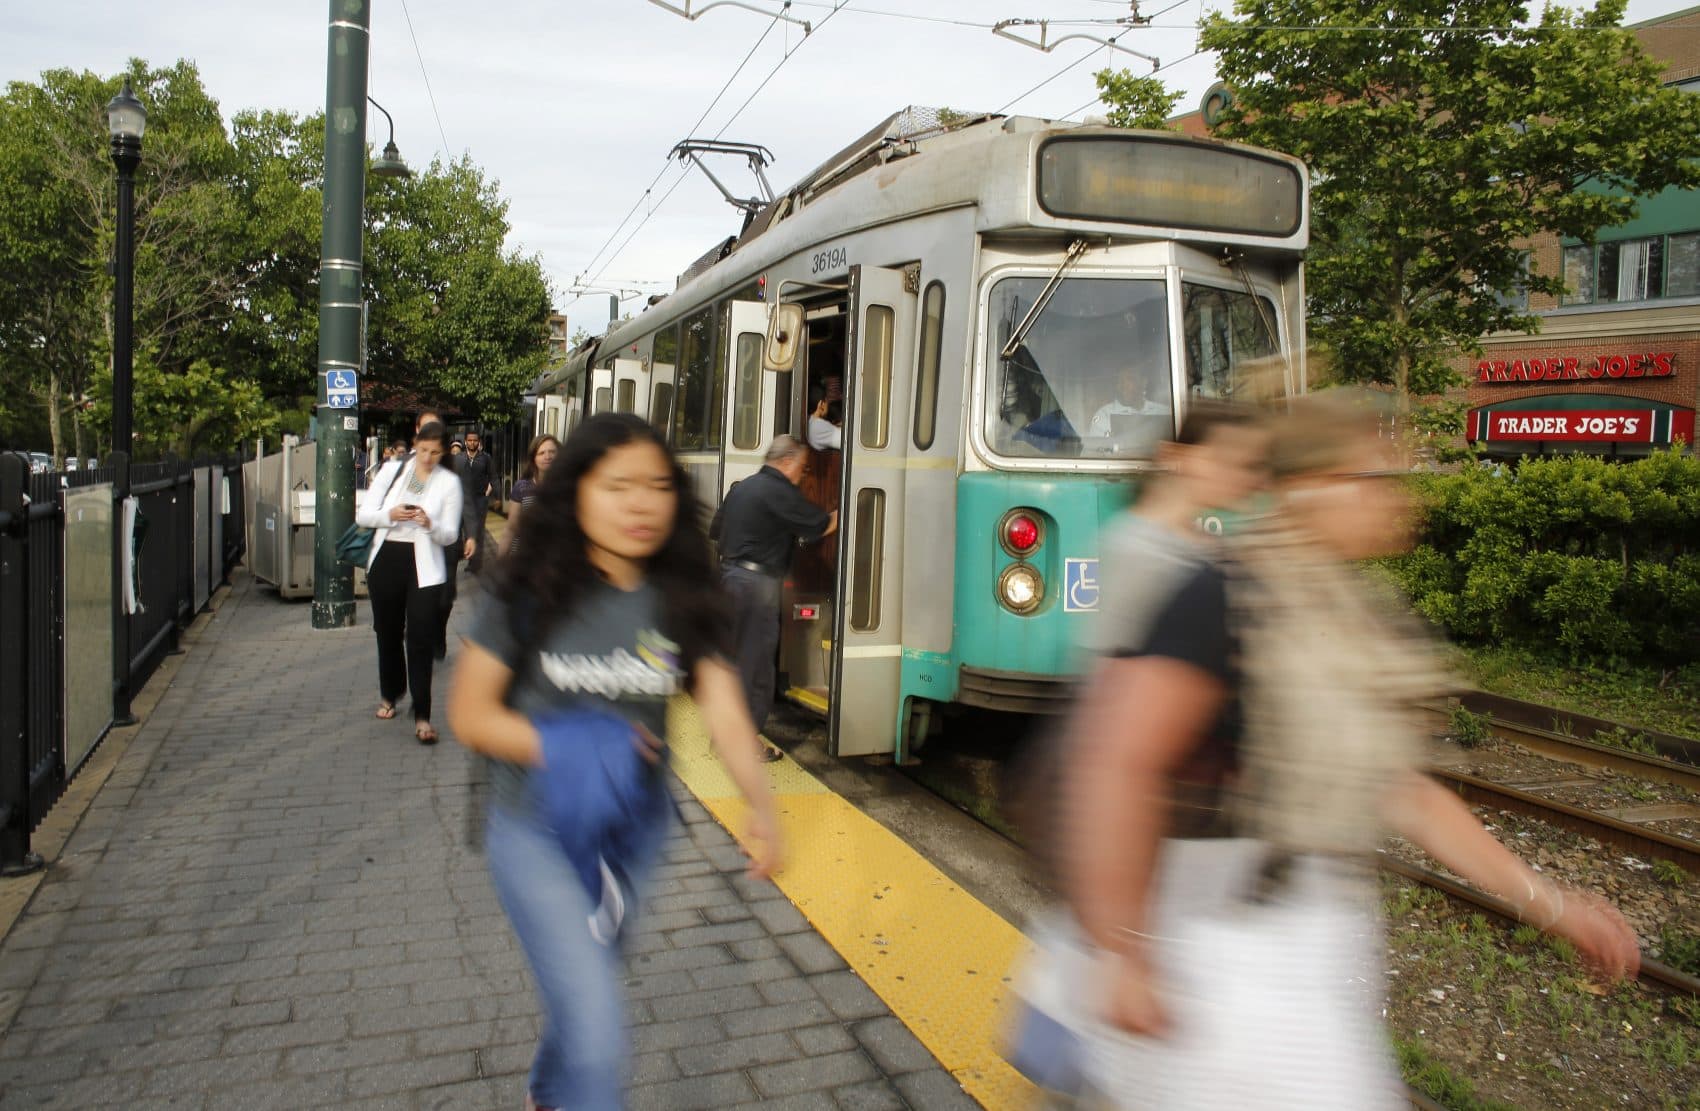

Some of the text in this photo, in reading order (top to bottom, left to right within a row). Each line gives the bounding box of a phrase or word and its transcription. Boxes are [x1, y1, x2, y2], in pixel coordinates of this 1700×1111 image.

[812, 247, 847, 274] 3619A
[1478, 352, 1674, 382] TRADER JOE'S
[1498, 416, 1640, 434] TRADER JOE'S
